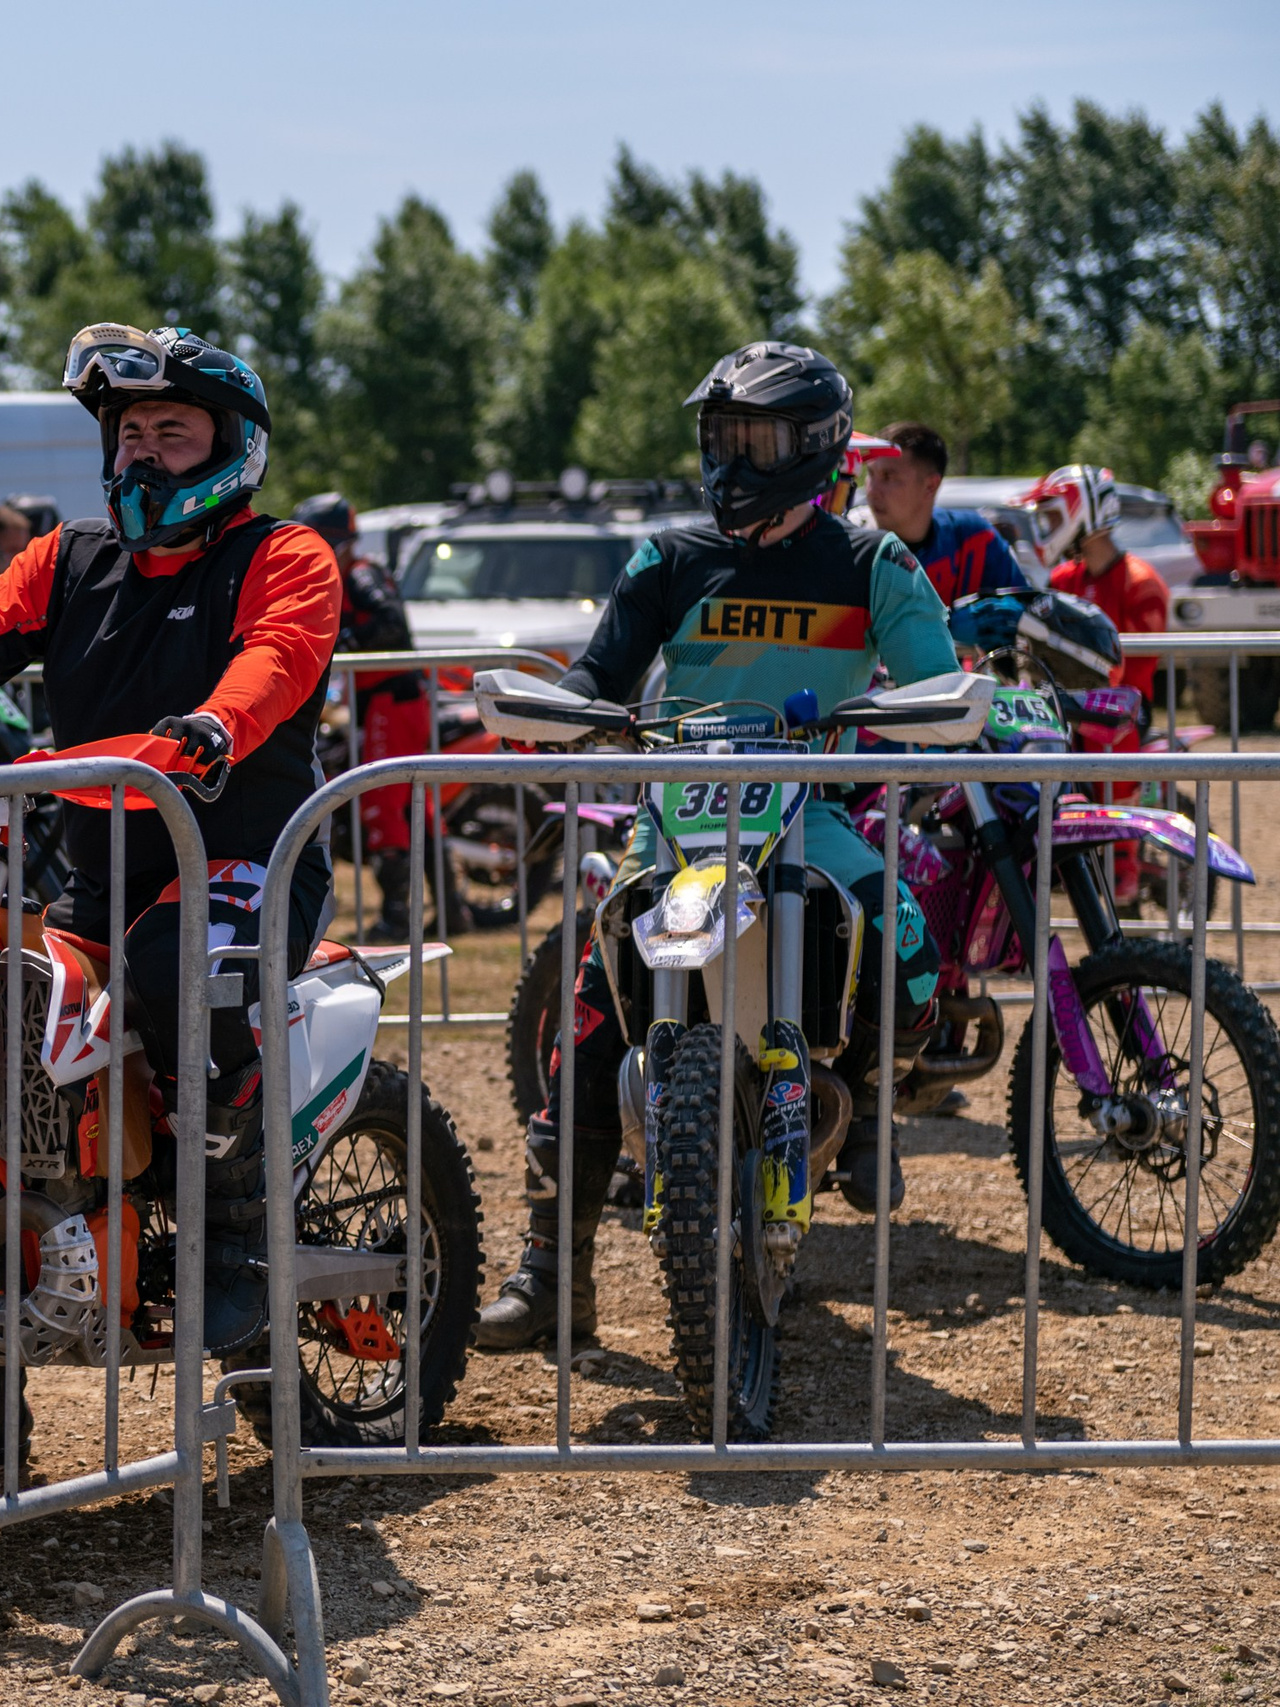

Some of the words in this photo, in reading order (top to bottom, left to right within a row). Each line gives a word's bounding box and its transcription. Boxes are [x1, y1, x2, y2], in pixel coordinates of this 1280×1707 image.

[167, 605, 195, 620] KTM
[700, 602, 817, 640] LEATT
[992, 695, 1053, 726] 345
[704, 722, 767, 736] Husqvarna
[25, 1159, 61, 1170] XTR
